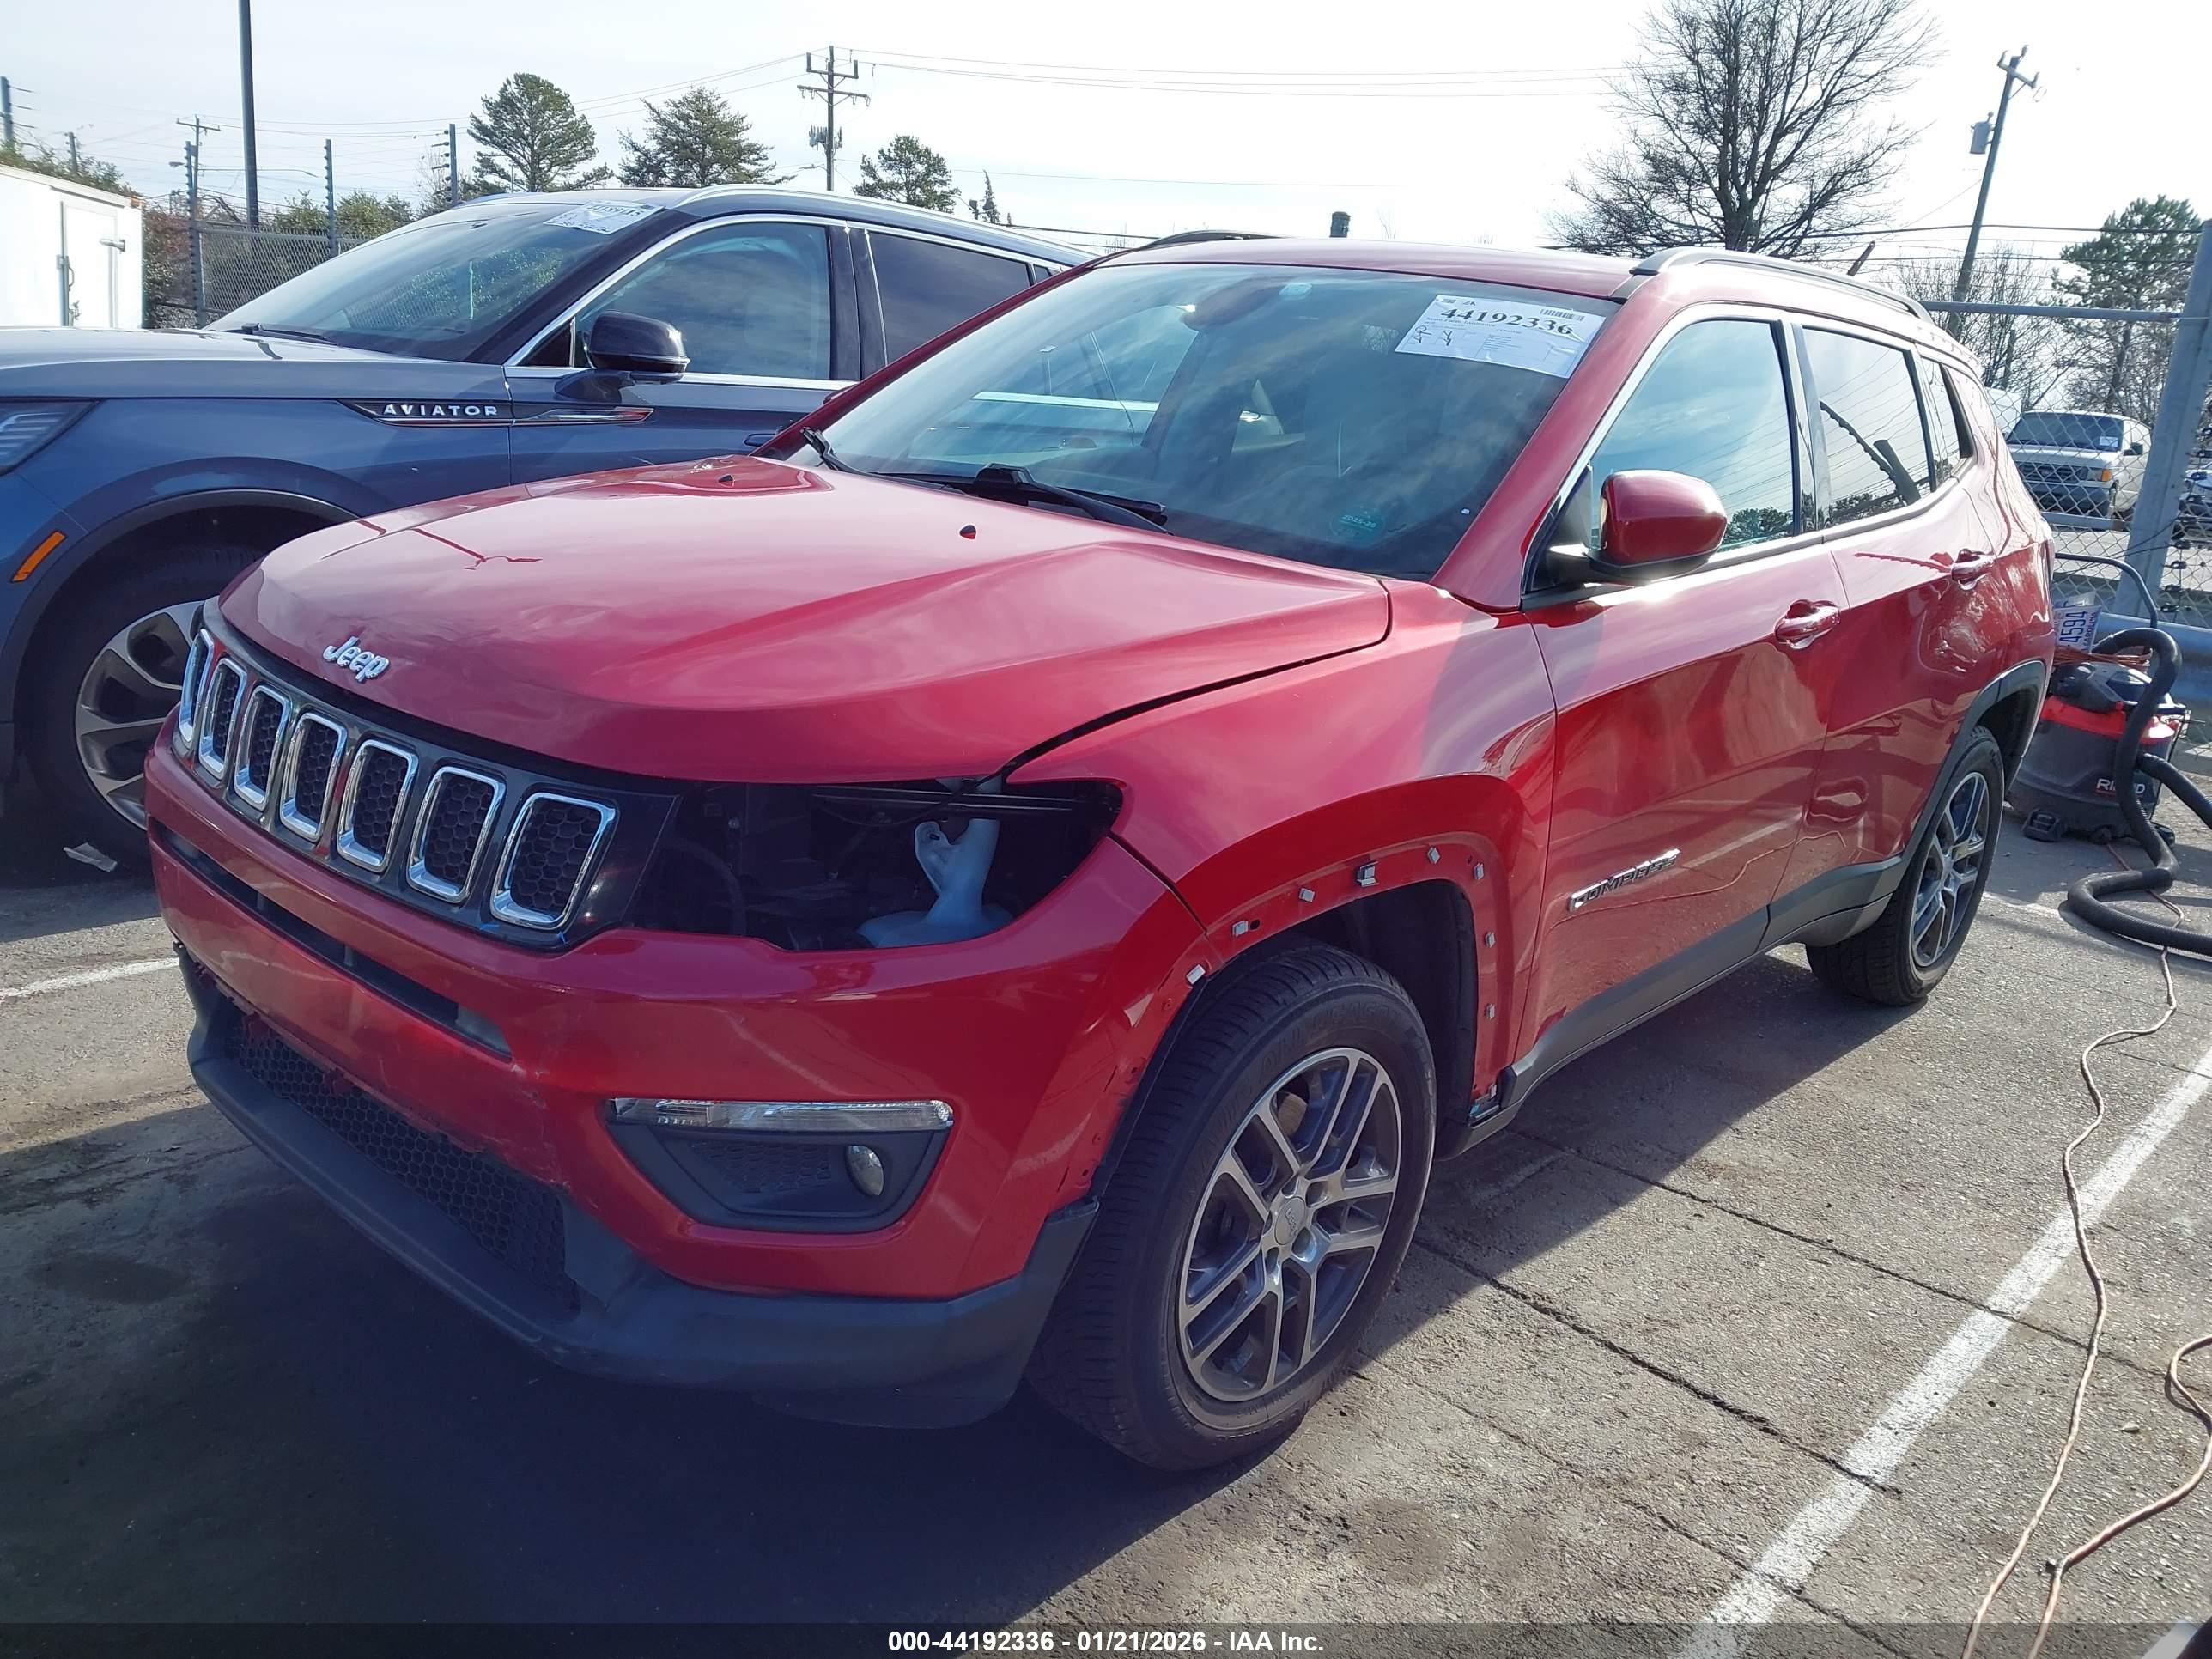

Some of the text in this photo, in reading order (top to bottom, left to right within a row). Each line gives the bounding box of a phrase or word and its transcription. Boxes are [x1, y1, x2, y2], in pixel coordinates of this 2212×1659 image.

[1440, 308, 1574, 336] 44192336
[383, 404, 498, 416] AVIATOR
[323, 635, 390, 683] Jeep
